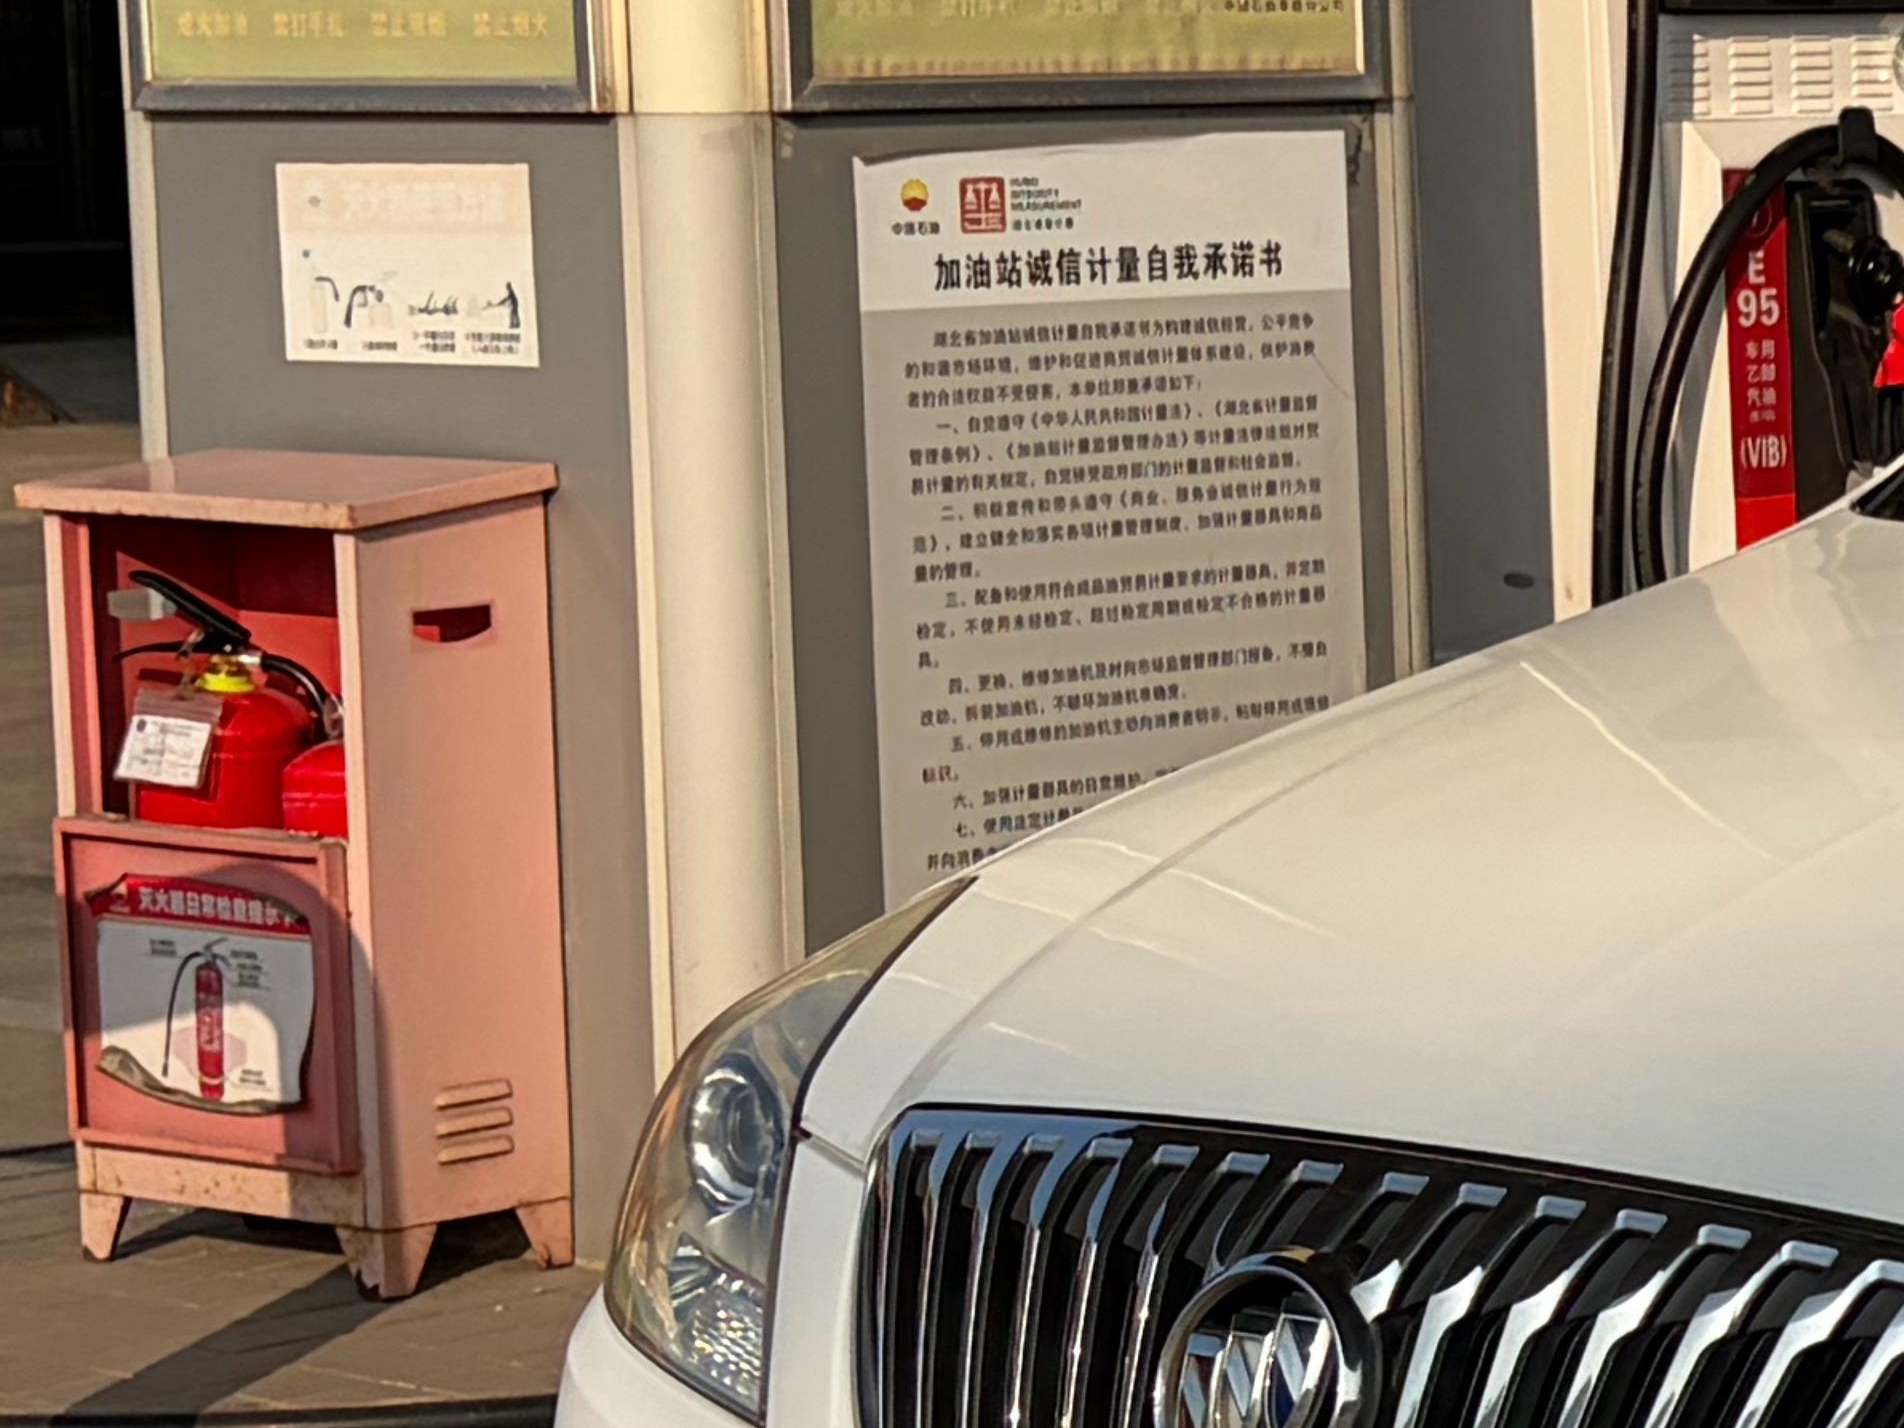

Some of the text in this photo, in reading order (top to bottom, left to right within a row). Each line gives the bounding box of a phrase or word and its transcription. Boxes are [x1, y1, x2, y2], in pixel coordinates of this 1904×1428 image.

[933, 241, 1284, 291] 加油站诚信计量自我承诺书
[1749, 251, 1766, 284] E
[1737, 288, 1780, 328] 95
